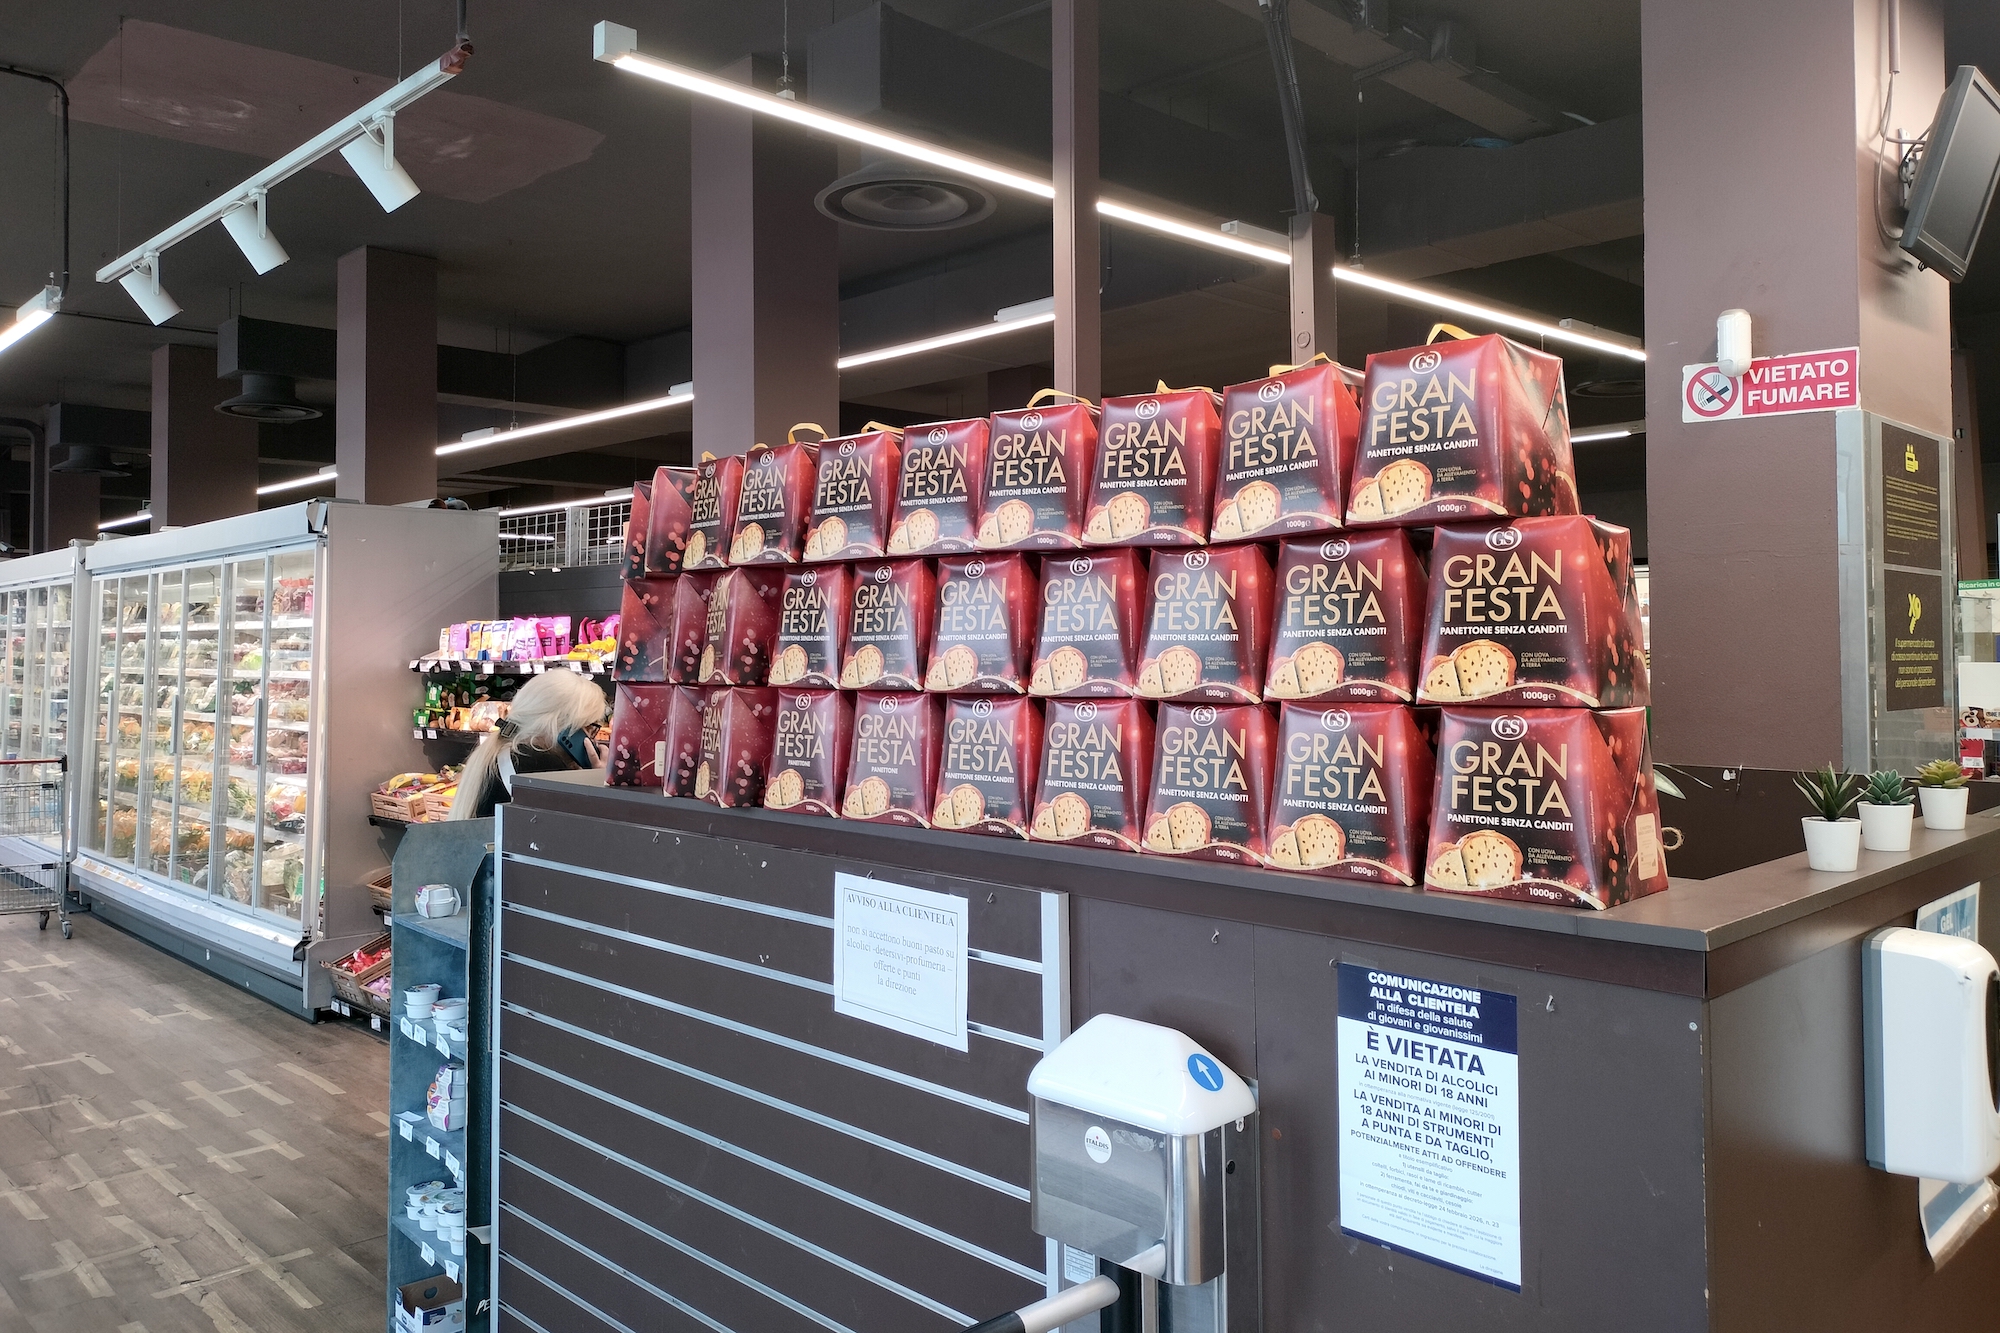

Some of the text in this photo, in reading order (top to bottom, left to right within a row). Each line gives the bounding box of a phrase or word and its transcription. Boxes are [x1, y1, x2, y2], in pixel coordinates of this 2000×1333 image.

[1749, 359, 1849, 385] VIETATO
[1371, 366, 1475, 414] GRAN
[1748, 382, 1850, 407] FUMARE
[1104, 416, 1186, 450] GRAN
[1228, 394, 1313, 441] GRAN
[1371, 402, 1477, 446] FESTA
[903, 442, 967, 473] GRAN
[992, 429, 1065, 461] GRAN
[1229, 427, 1317, 470] FESTA
[1368, 438, 1478, 458] PANETTONE SENZA CANDITI
[817, 453, 872, 484] GRAN
[992, 456, 1065, 487] FESTA
[1103, 446, 1185, 478] FESTA
[742, 464, 786, 492] GRAN
[817, 477, 871, 506] FESTA
[903, 468, 967, 497] FESTA
[741, 487, 784, 513] FESTA
[1285, 558, 1382, 596] GRAN
[1443, 548, 1561, 588] GRAN
[782, 585, 831, 611] GRAN
[854, 581, 908, 609] GRAN
[940, 577, 1007, 607] GRAN
[1043, 574, 1116, 605] GRAN
[1153, 569, 1236, 601] GRAN
[940, 604, 1007, 632] FESTA
[1044, 602, 1117, 632] FESTA
[1153, 599, 1237, 630] FESTA
[1286, 591, 1385, 626] FESTA
[1444, 585, 1565, 622] FESTA
[781, 609, 829, 633] FESTA
[854, 606, 908, 633] FESTA
[1283, 627, 1386, 638] PANETTONE SENZA CANDITI
[1441, 625, 1567, 635] PANETTONE SENZA CANDITI
[778, 710, 826, 735] GRAN
[857, 713, 916, 741] GRAN
[948, 719, 1013, 746] GRAN
[1047, 722, 1121, 752] GRAN
[776, 734, 825, 759] FESTA
[857, 738, 916, 766] FESTA
[947, 744, 1013, 773] FESTA
[1160, 727, 1245, 759] GRAN
[1286, 732, 1383, 767] GRAN
[871, 766, 898, 774] PANETTONE
[1048, 749, 1122, 781] FESTA
[1161, 756, 1247, 790] FESTA
[1449, 740, 1568, 780] GRAN
[1158, 788, 1248, 802] PANETTONE SENZA CANDITI
[1287, 763, 1386, 801] FESTA
[1451, 774, 1571, 817] FESTA
[1284, 799, 1387, 814] PANETTONE SENZA CANDITI
[1447, 813, 1573, 831] PANETTONE SENZA CANDITI
[846, 892, 954, 927] AVVISO ALLA CLIENTELA
[846, 937, 945, 974] alcolici -detersivi-profumeria
[847, 924, 954, 958] non si accettono buoni pasto su
[873, 958, 895, 974] offerte
[903, 967, 920, 982] punti
[877, 974, 916, 995] la direzione
[1367, 971, 1481, 1004] COMUNICAZIONE
[1369, 985, 1479, 1018] ALLA CLIENTELA
[1367, 1009, 1482, 1044] di giovani e giovanissimi
[1376, 1000, 1473, 1029] in difesa della salute
[1366, 1024, 1485, 1076] È VIETATA
[1355, 1053, 1497, 1096] LA VENDITA DI ALCOLICI
[1364, 1068, 1488, 1108] AI MINORI DI 18 ANNI
[1353, 1088, 1500, 1135] LA VENDITA AI MINORI DI
[1360, 1103, 1493, 1148] 18 ANNI DI STRUMENTI
[1086, 1138, 1108, 1150] ITALDIS
[1350, 1128, 1506, 1179] POTENZIALMENTE ATTI AD OFFENDERE
[1361, 1117, 1492, 1164] A PUNTA E DA TAGLIO,
